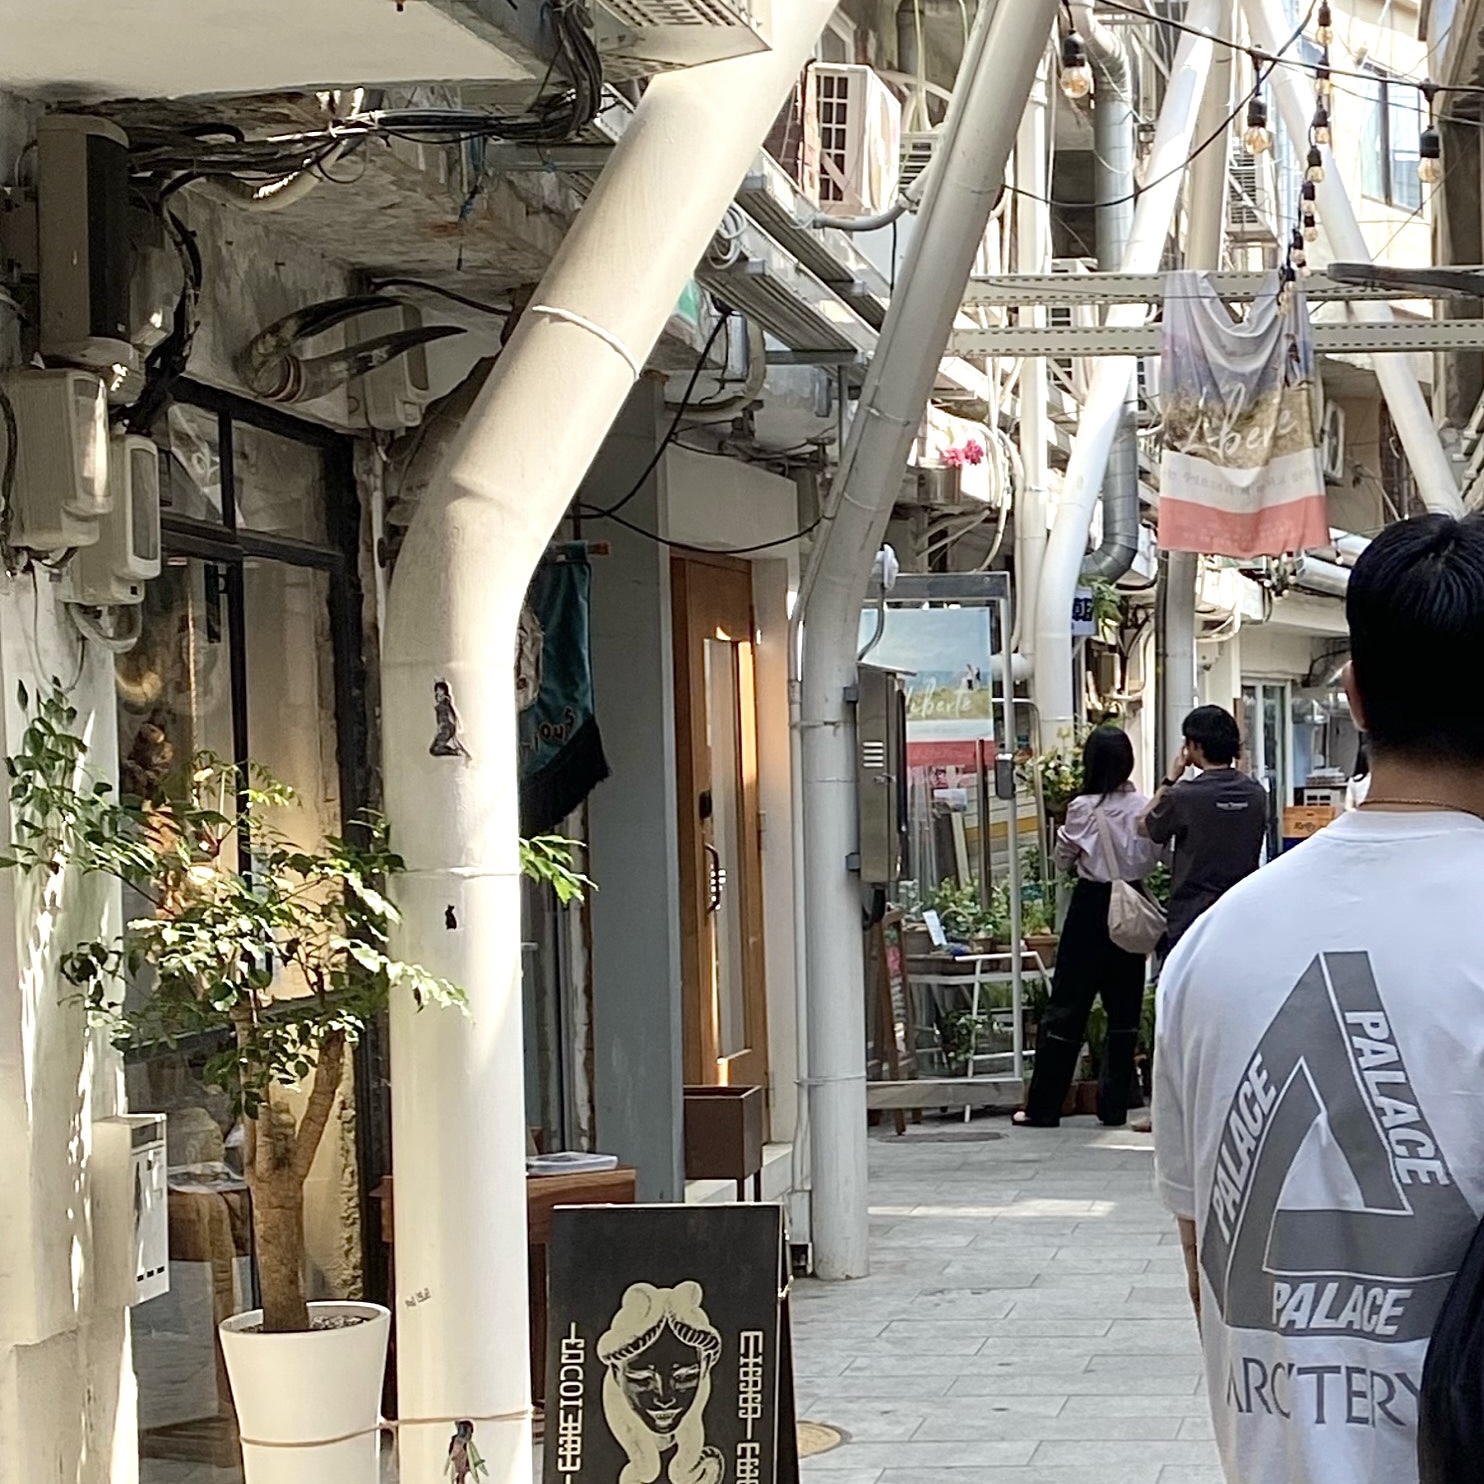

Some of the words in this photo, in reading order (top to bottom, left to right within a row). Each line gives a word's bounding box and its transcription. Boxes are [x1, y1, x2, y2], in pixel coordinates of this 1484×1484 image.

[1211, 1053, 1279, 1244] PALACE
[1344, 1009, 1450, 1186] PALACE
[1271, 1282, 1413, 1336] PALACE
[1226, 1356, 1421, 1428] ARC'TERY
